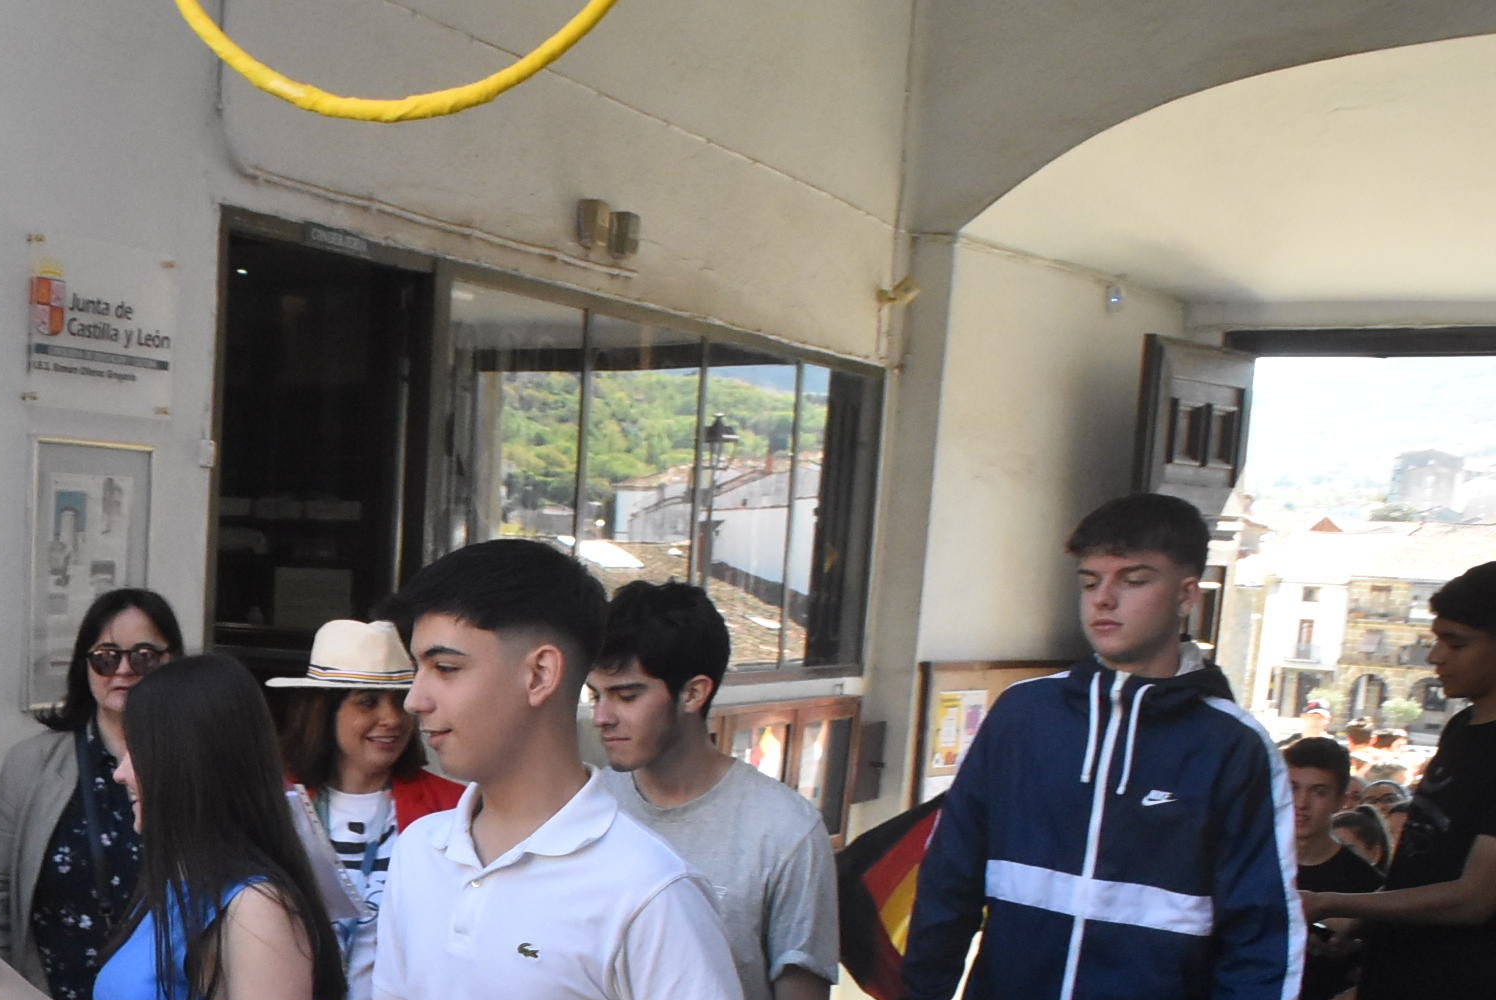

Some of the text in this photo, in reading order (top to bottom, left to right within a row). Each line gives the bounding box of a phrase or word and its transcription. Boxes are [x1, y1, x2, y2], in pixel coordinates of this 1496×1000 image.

[68, 292, 134, 321] Junta de
[67, 317, 171, 350] Castilla y León
